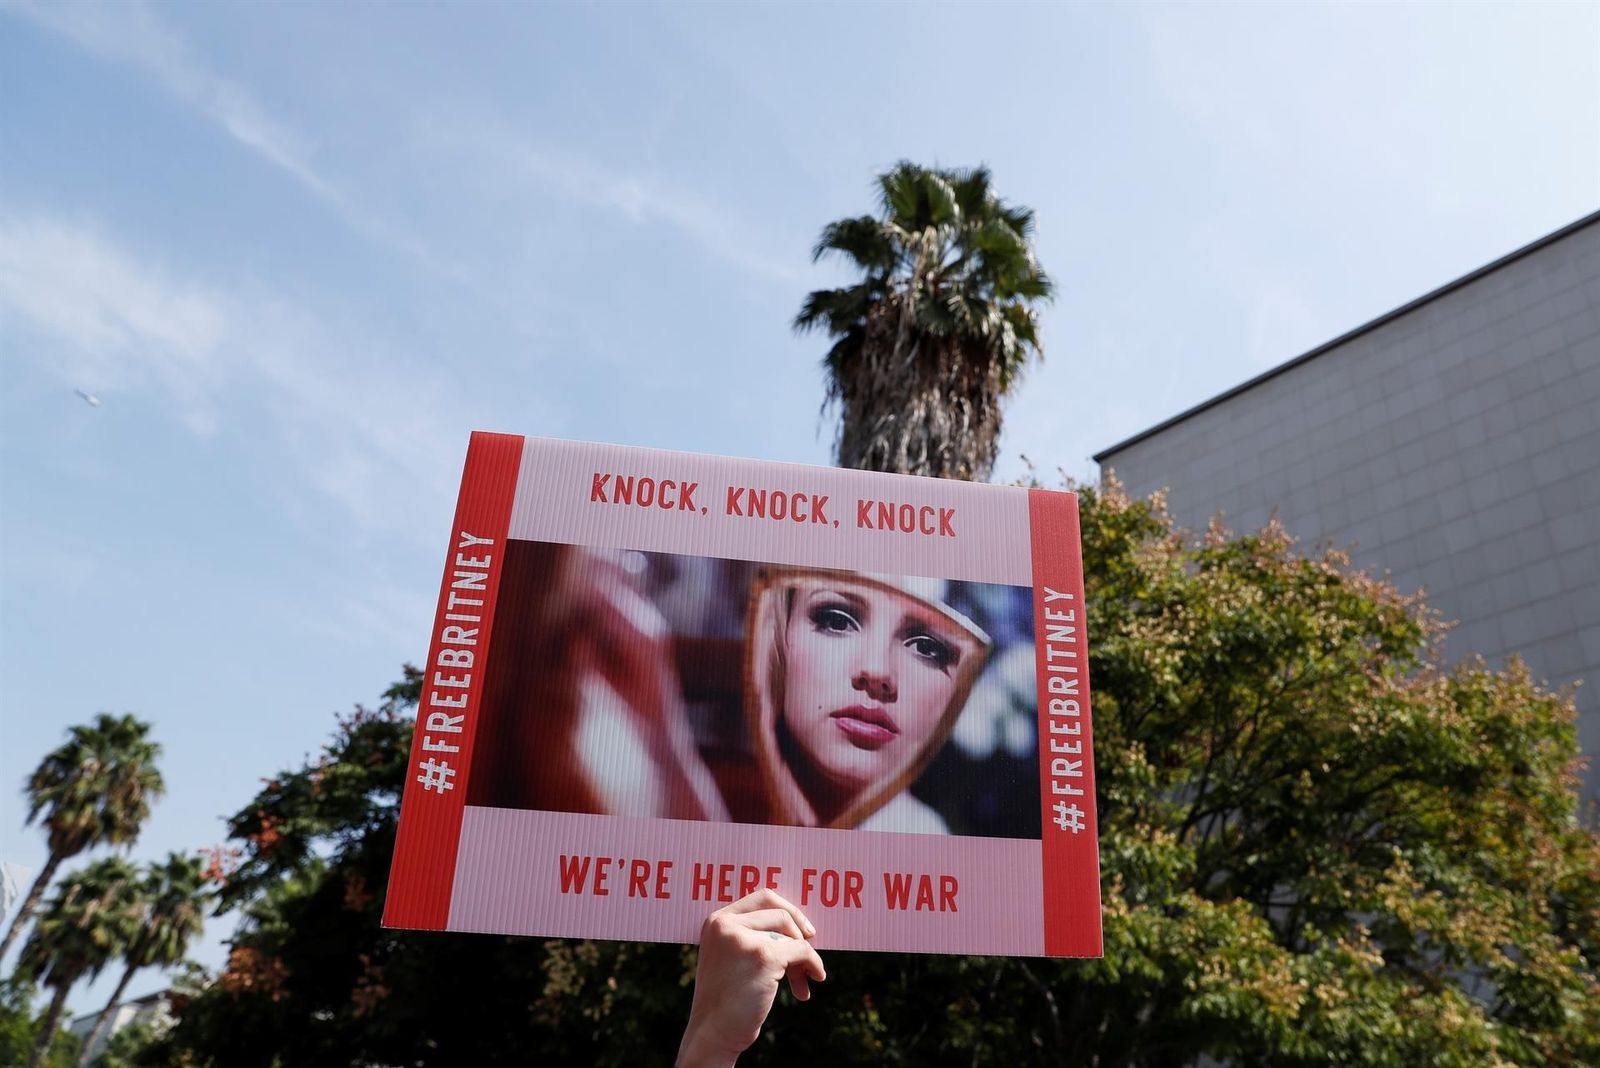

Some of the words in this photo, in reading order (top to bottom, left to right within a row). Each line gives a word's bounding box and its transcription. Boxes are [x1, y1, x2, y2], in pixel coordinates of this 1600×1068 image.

[590, 473, 708, 516] KNOCK,
[725, 486, 840, 528] KNOCK,
[857, 499, 957, 537] KNOCK
[416, 531, 495, 794] #FREEBRITNEY
[1043, 586, 1086, 834] #FREEBRITNEY
[559, 854, 674, 899] WE'RE
[801, 867, 865, 909] FOR
[883, 872, 960, 913] WAR
